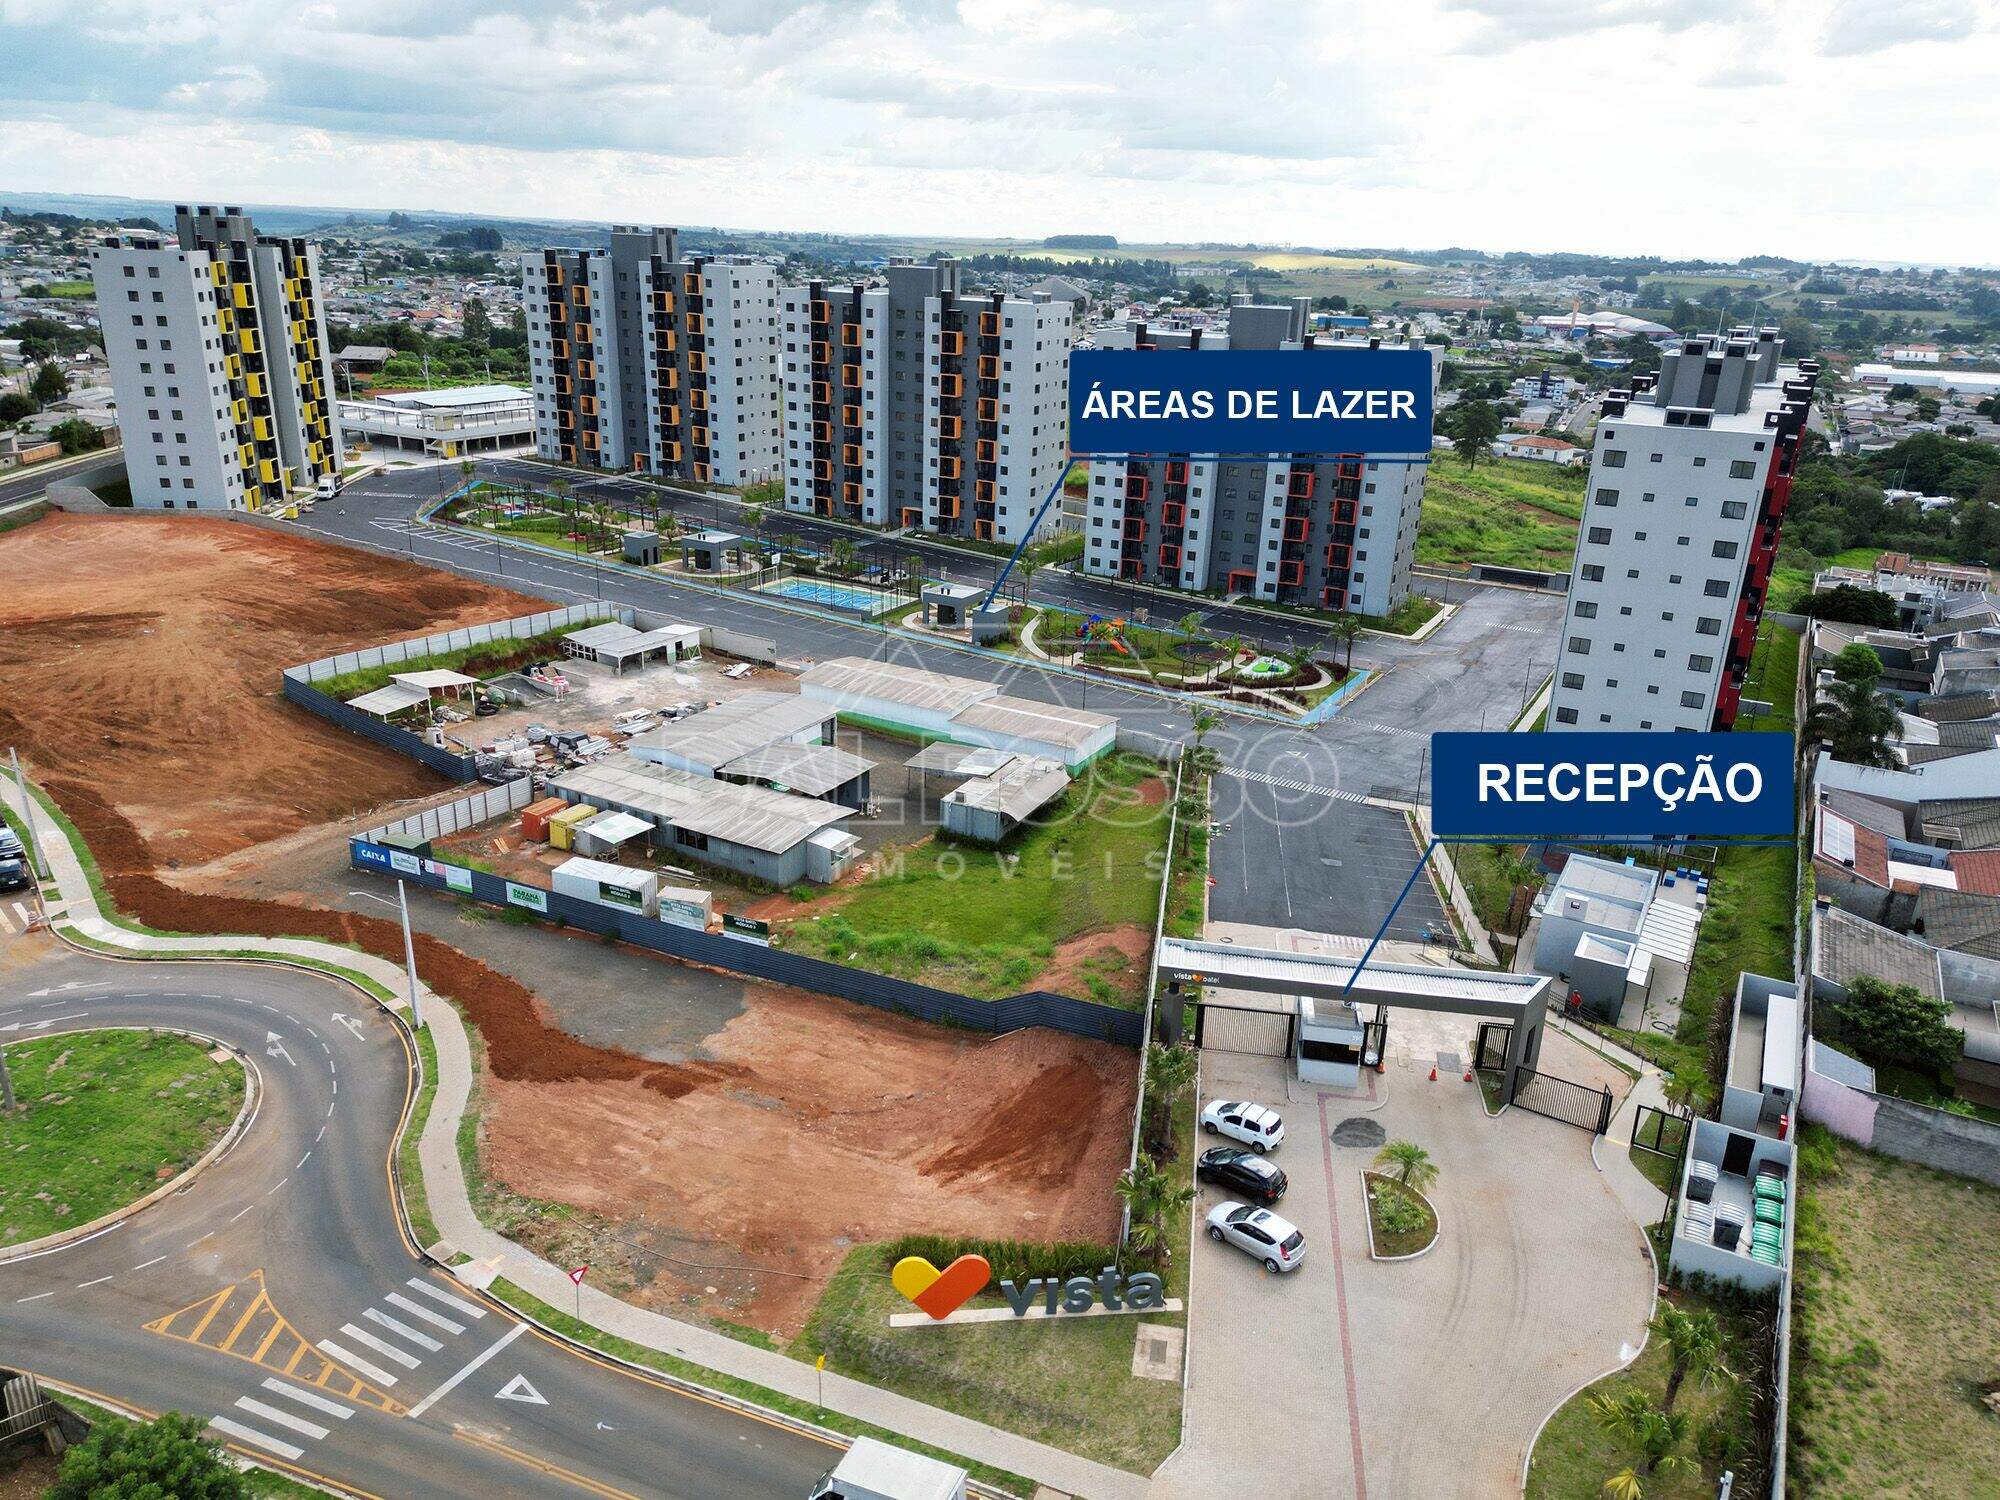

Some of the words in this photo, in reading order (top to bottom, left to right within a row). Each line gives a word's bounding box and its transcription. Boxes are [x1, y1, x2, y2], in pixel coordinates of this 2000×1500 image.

[361, 849, 386, 863] CAIXA
[1173, 972, 1192, 981] vista
[1000, 1266, 1166, 1316] vista
